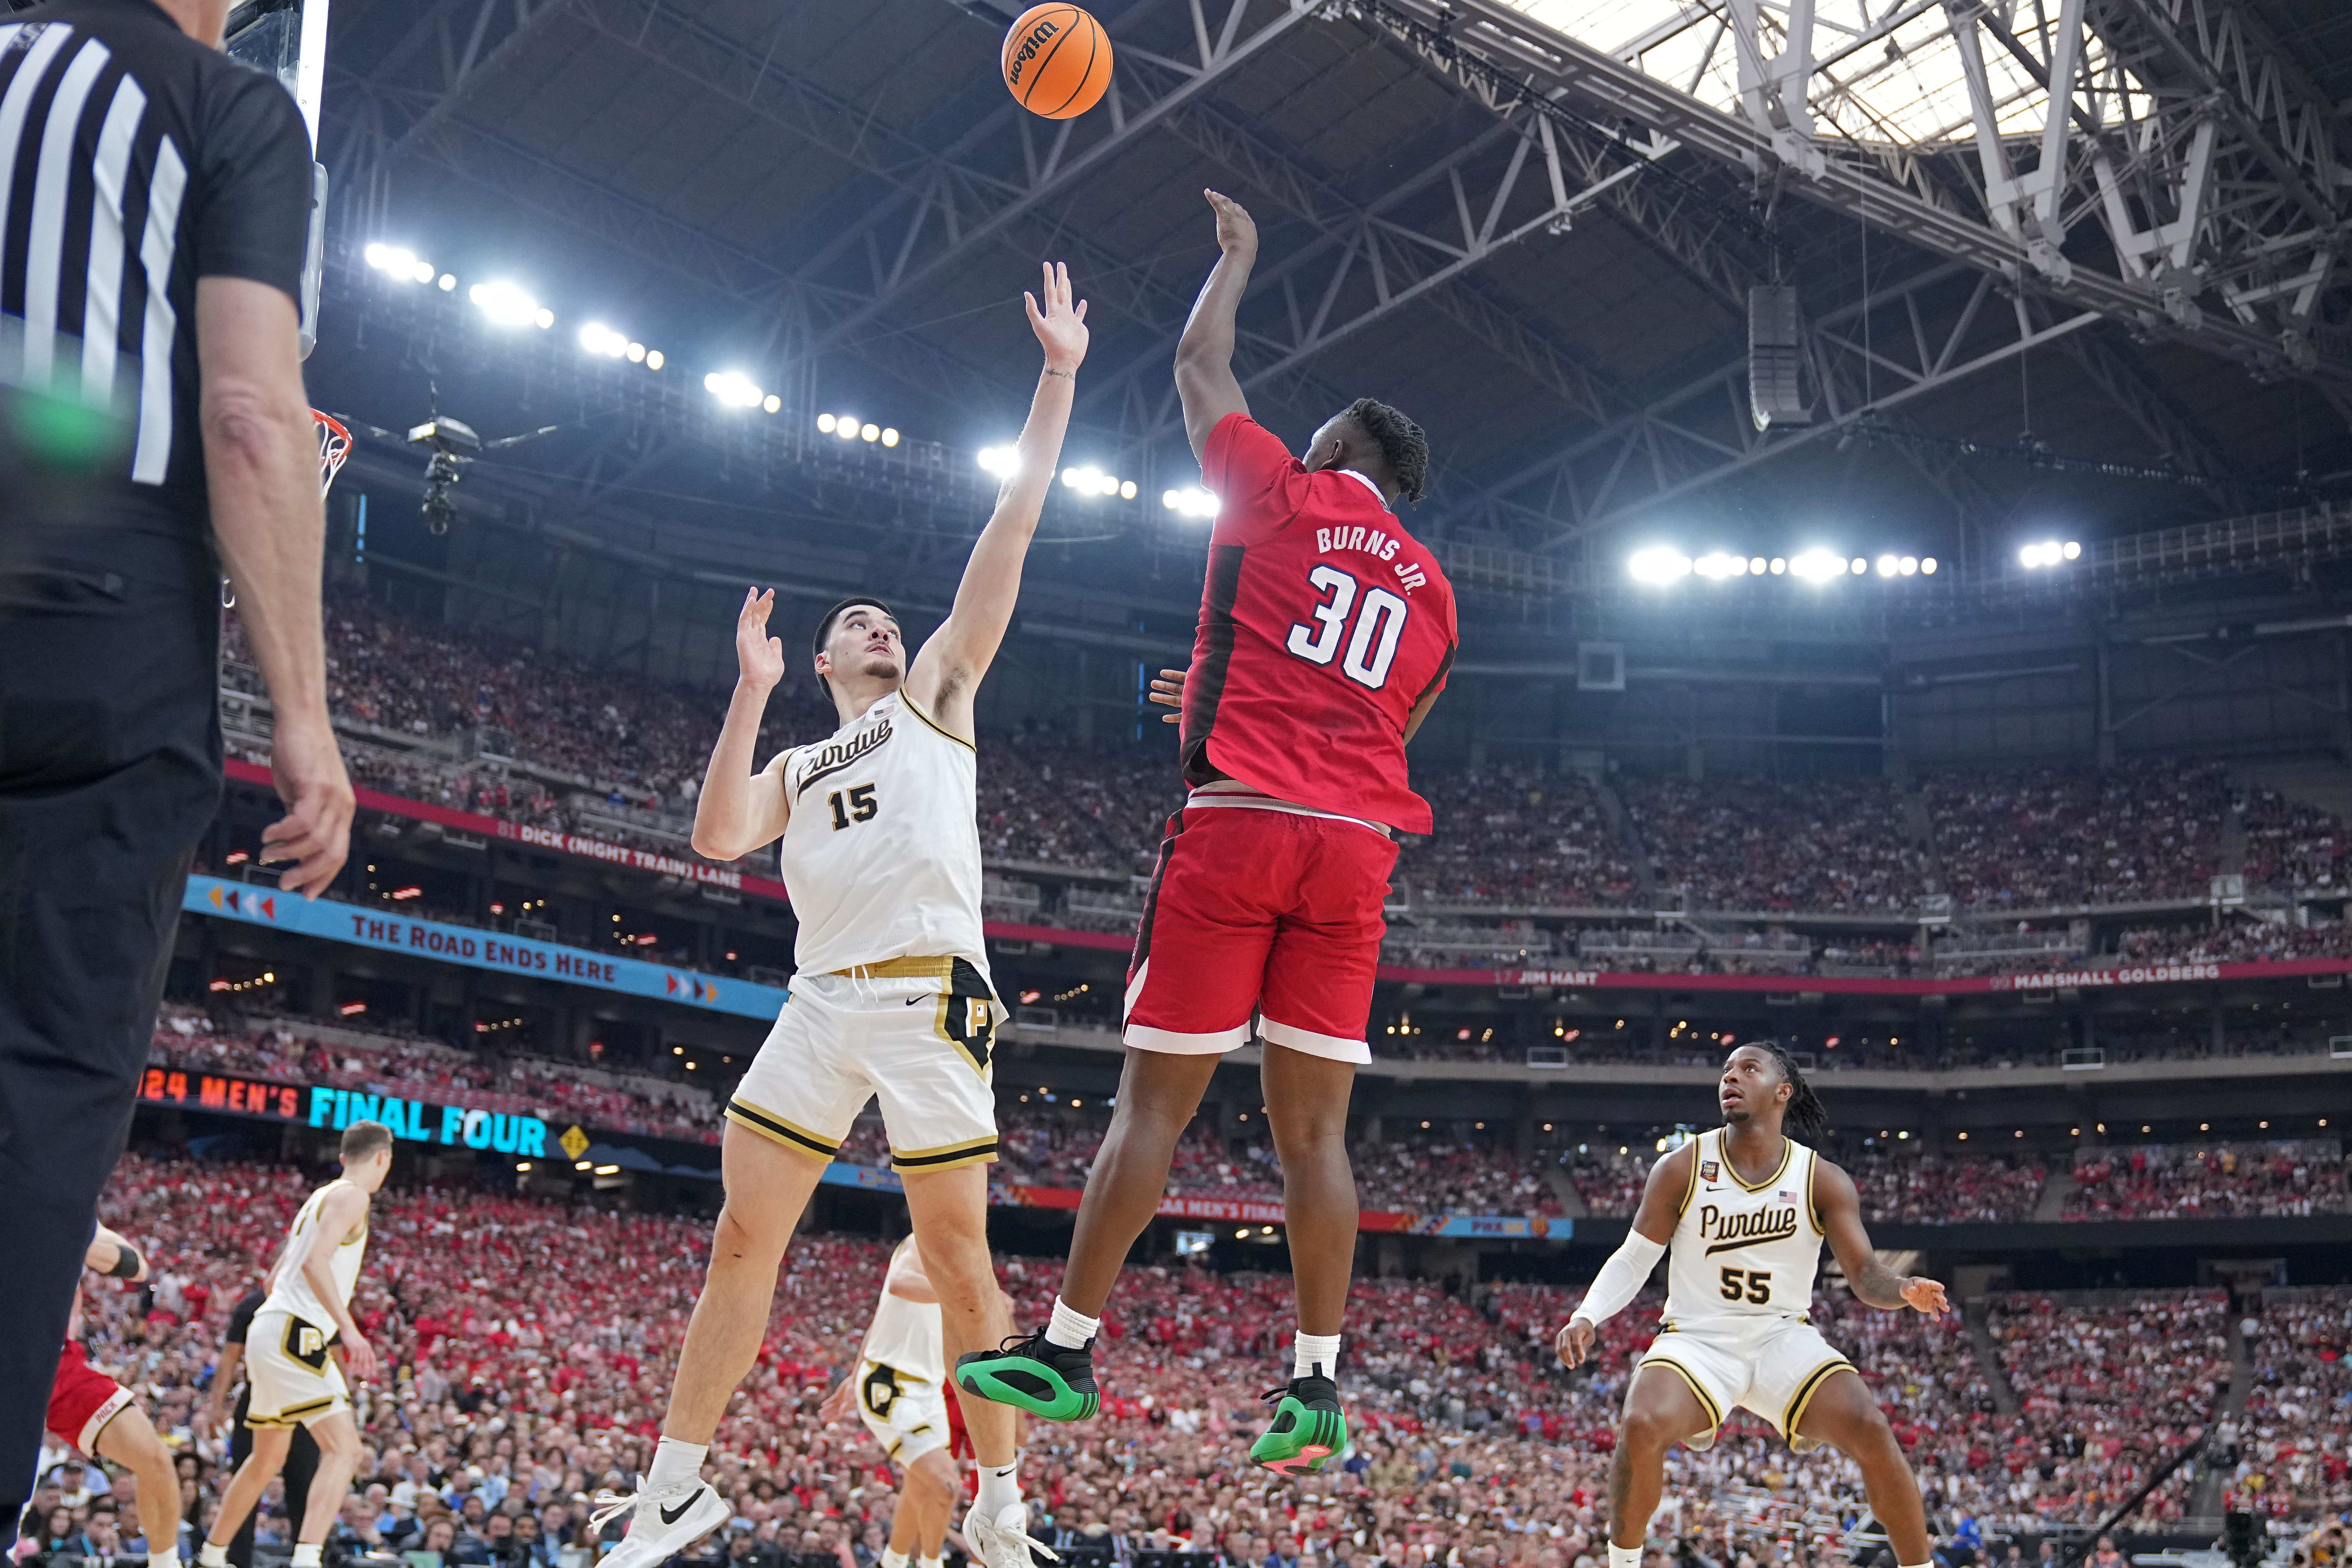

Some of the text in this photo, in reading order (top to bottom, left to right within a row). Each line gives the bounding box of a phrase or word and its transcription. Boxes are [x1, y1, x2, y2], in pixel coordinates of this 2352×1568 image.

[1010, 20, 1060, 85] Wilson
[1317, 526, 1426, 596] BURNS JR.
[1284, 563, 1408, 692] 30
[796, 718, 893, 790] Purdue
[828, 782, 878, 831] 15
[520, 825, 564, 848] DICK
[567, 839, 630, 863] (NIGHT
[634, 852, 693, 878] TRAIN)
[697, 865, 741, 889] LANE
[352, 916, 616, 983] THE ROAD ENDS HERE
[1519, 971, 1547, 985] JIM
[1550, 971, 1598, 985] HART
[2014, 970, 2114, 988] MARSHALL
[2118, 964, 2220, 983] GOLDBERG
[136, 1068, 299, 1118] 24 MEN'S
[308, 1086, 546, 1158] FINAL FOUR
[1187, 1200, 1239, 1219] MEN'S
[1699, 1202, 1797, 1241] Purdue
[1720, 1265, 1772, 1305] 55
